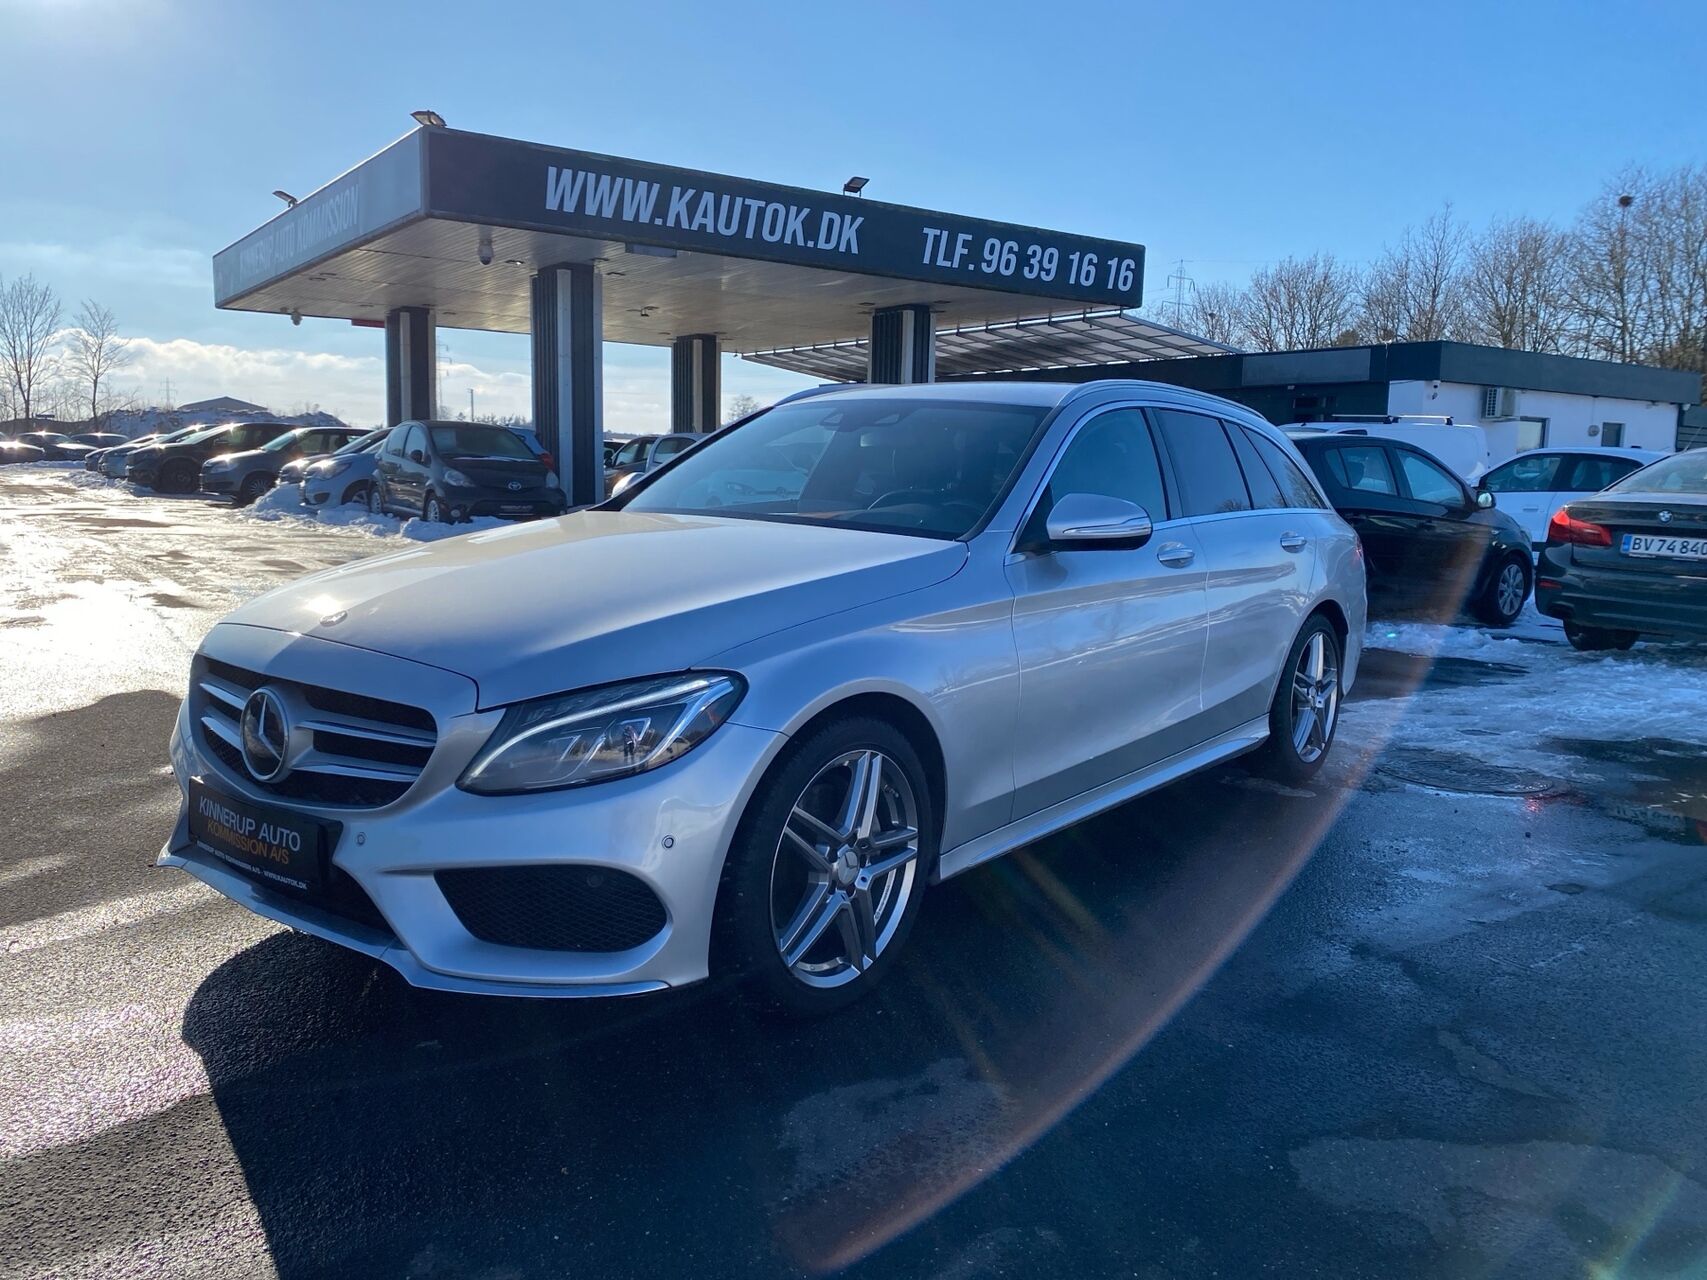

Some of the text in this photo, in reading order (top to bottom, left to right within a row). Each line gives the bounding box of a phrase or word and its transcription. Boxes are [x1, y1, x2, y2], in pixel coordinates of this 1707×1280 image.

[545, 165, 865, 255] WWW.KAUTOK.DK
[922, 227, 1136, 291] TLF. 96 39 16 16
[1632, 538, 1655, 551] BV
[1656, 539, 1678, 553] 74
[199, 796, 301, 852] KINNERUP AUTO
[207, 819, 267, 858] KOMMISSION
[269, 847, 289, 864] A/S
